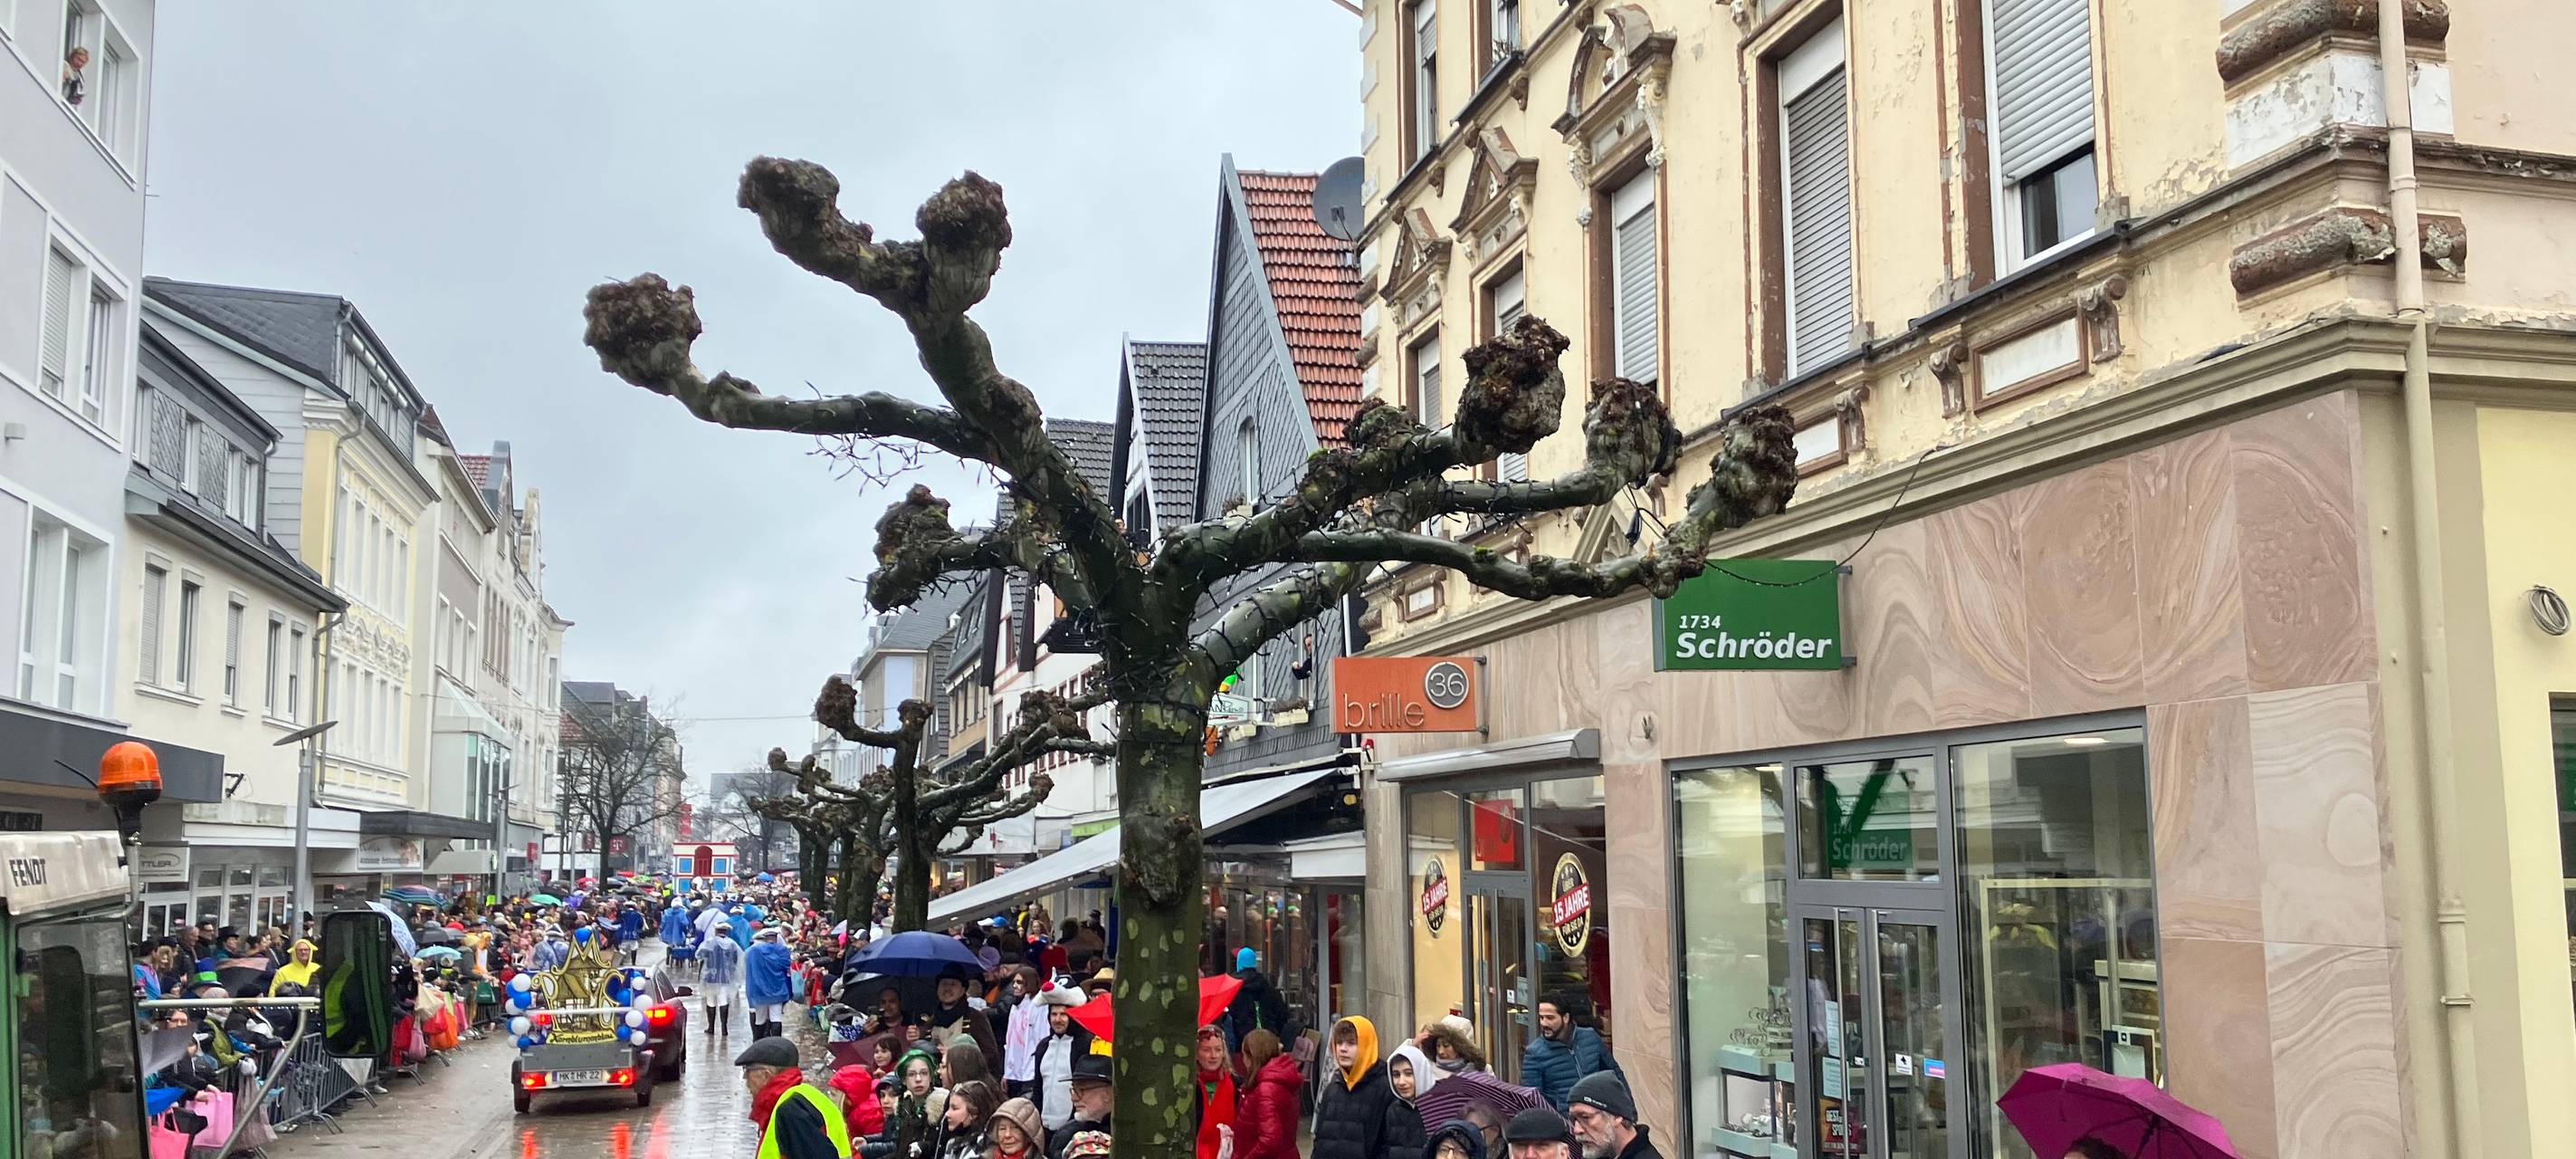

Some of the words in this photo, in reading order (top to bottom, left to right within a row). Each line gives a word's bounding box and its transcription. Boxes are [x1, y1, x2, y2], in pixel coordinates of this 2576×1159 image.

[1679, 615, 1722, 629] 1734
[1675, 631, 1832, 659] Schröder
[1430, 672, 1465, 697] 36
[1343, 693, 1425, 728] brille
[1832, 836, 1907, 860] Schröder
[9, 857, 47, 887] FENDT
[1553, 901, 1564, 924] 15
[1564, 886, 1589, 918] JAHRE
